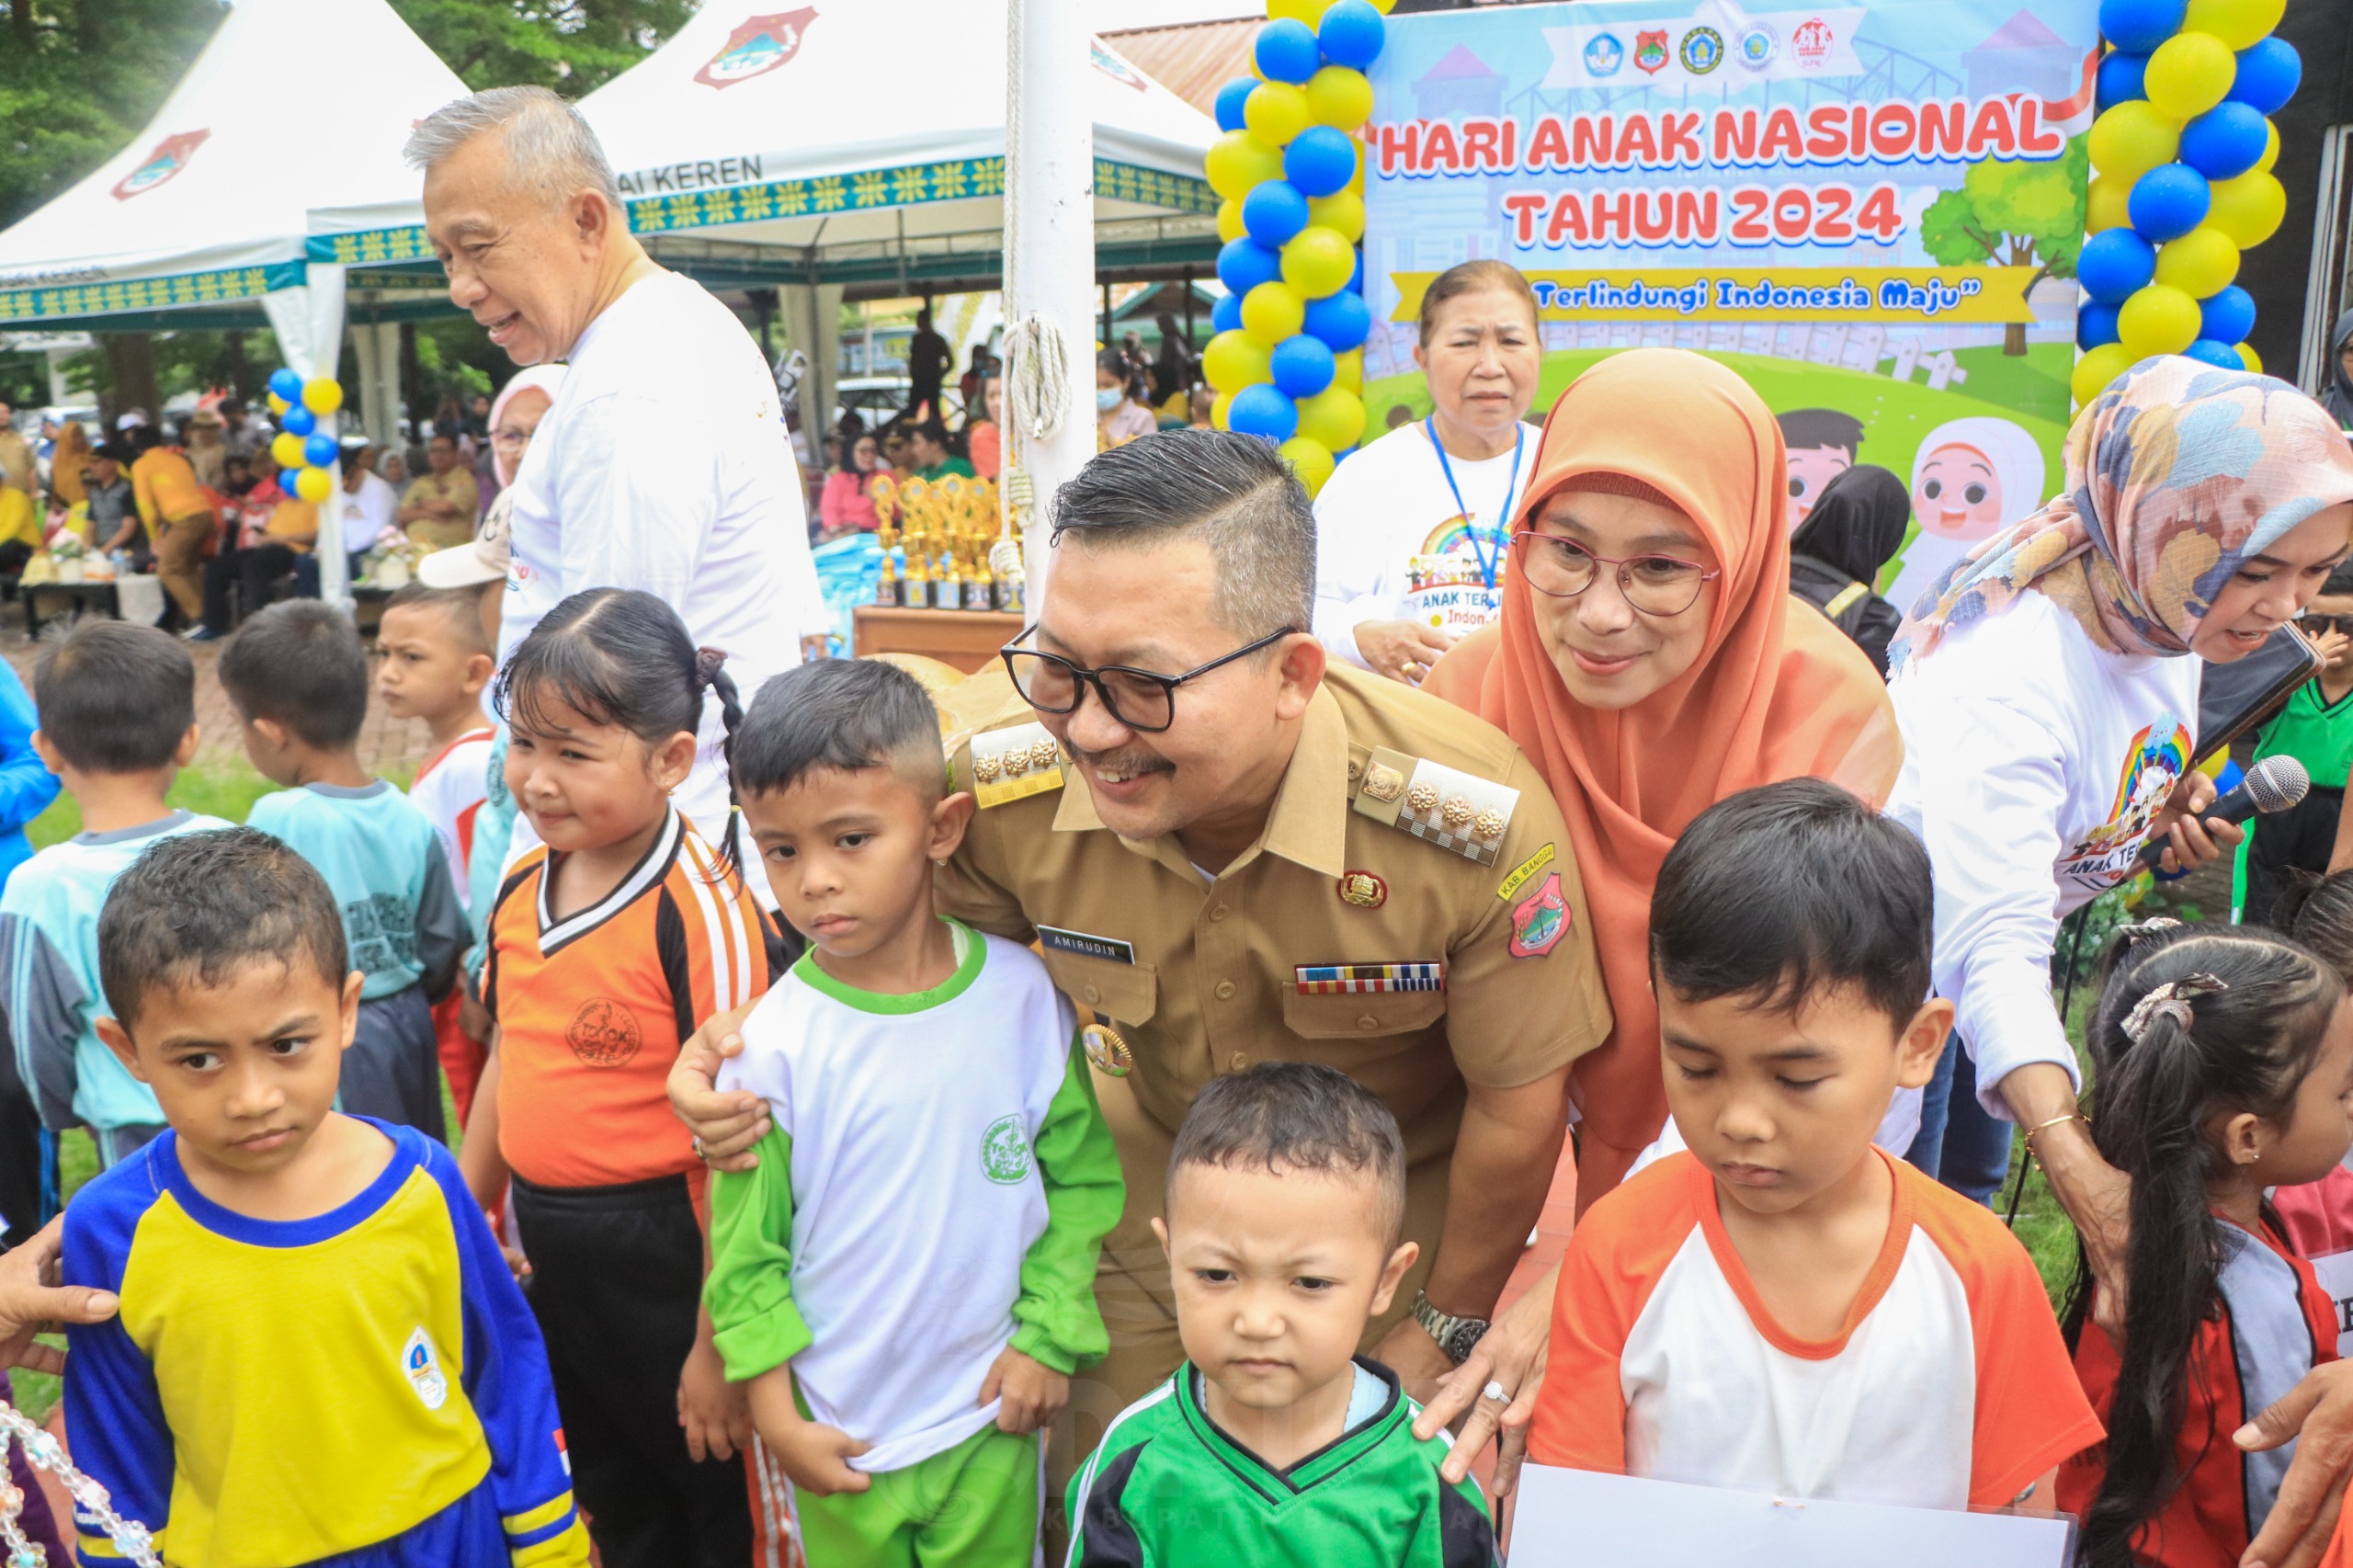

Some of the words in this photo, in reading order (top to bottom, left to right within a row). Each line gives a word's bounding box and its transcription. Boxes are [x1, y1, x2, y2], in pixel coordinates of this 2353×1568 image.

[1380, 119, 1518, 175] HARI
[1525, 109, 1702, 170] ANAK
[1711, 97, 2063, 162] NASIONAL
[653, 153, 763, 192] KEREN
[1504, 187, 1720, 244] TAHUN
[1730, 184, 1904, 241] 2024
[1532, 279, 1707, 312] Terlindungi
[1716, 279, 1870, 307] Indonesia
[1422, 591, 1460, 608] ANAK
[1500, 874, 1523, 895] KAB.
[1521, 846, 1553, 877] BANGGAI
[2063, 853, 2114, 874] ANAK
[1053, 936, 1116, 956] AMIRUDIN
